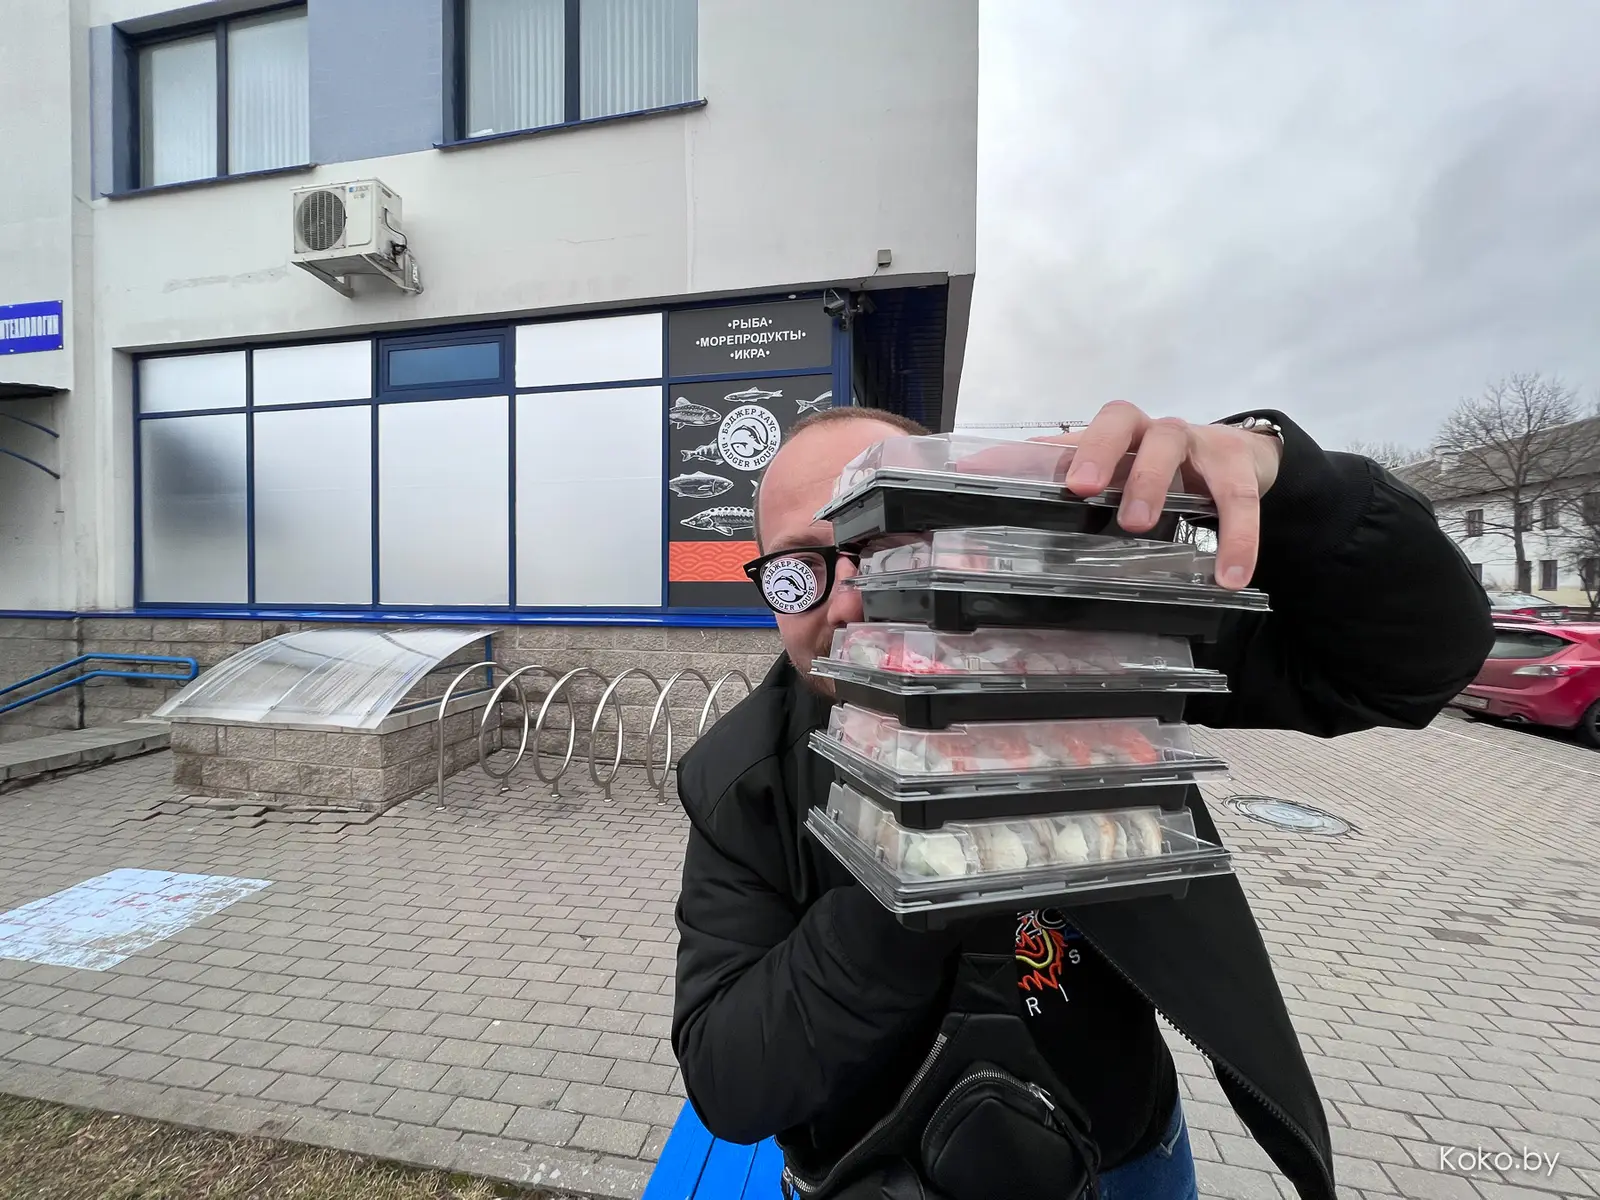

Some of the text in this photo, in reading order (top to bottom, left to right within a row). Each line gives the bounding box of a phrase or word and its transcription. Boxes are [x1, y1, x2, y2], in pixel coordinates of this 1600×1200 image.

[722, 408, 777, 435] БЭДЖЕР ХАУС
[722, 440, 778, 468] BADGER HOUSE
